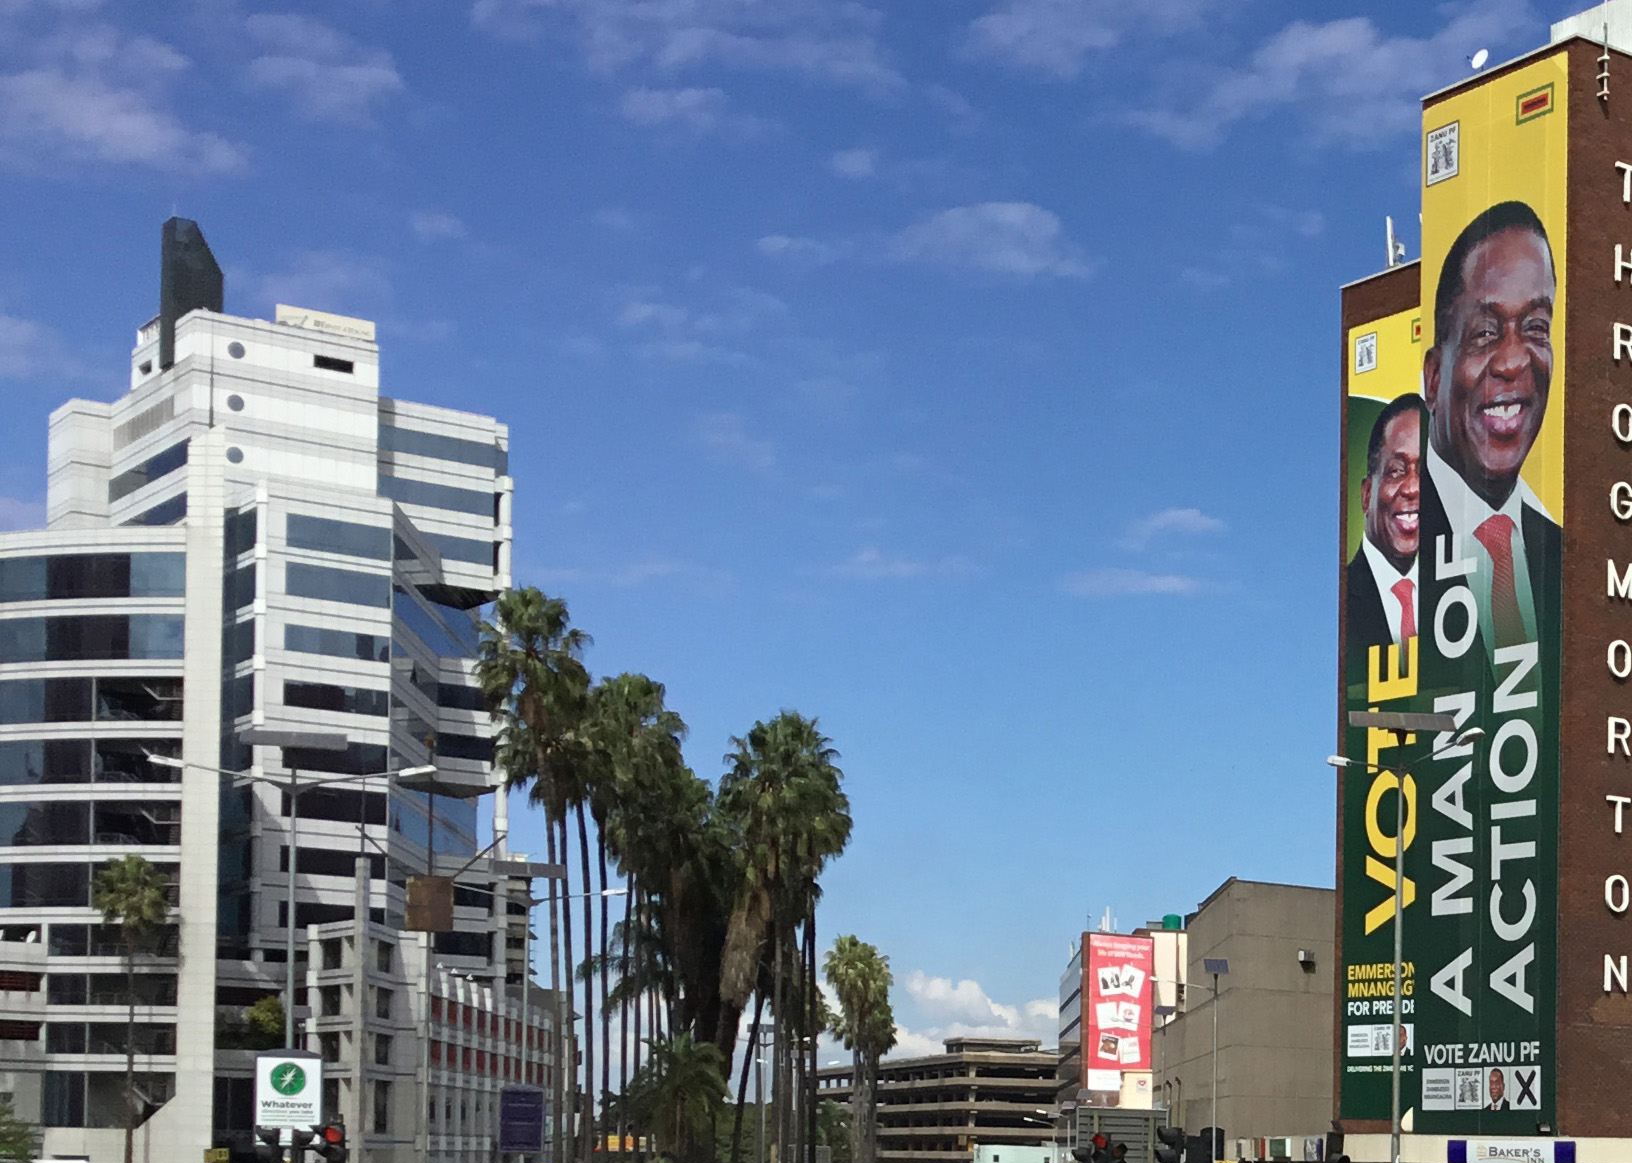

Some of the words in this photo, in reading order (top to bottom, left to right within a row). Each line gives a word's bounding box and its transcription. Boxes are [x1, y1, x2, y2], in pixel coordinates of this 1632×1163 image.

[1433, 533, 1478, 659] OF
[1365, 635, 1419, 936] VOTE
[1431, 691, 1476, 917] MAN
[1489, 640, 1540, 1014] ACTION
[1348, 981, 1414, 998] MNANGG
[1431, 946, 1473, 1018] A
[1348, 1002, 1370, 1017] FOR
[1373, 1000, 1415, 1015] PREDE
[1424, 1044, 1465, 1065] VOTE
[1468, 1042, 1515, 1064] ZANU
[1520, 1041, 1541, 1063] PF
[261, 1100, 313, 1109] Whatever
[1488, 1146, 1541, 1158] BAKER'S
